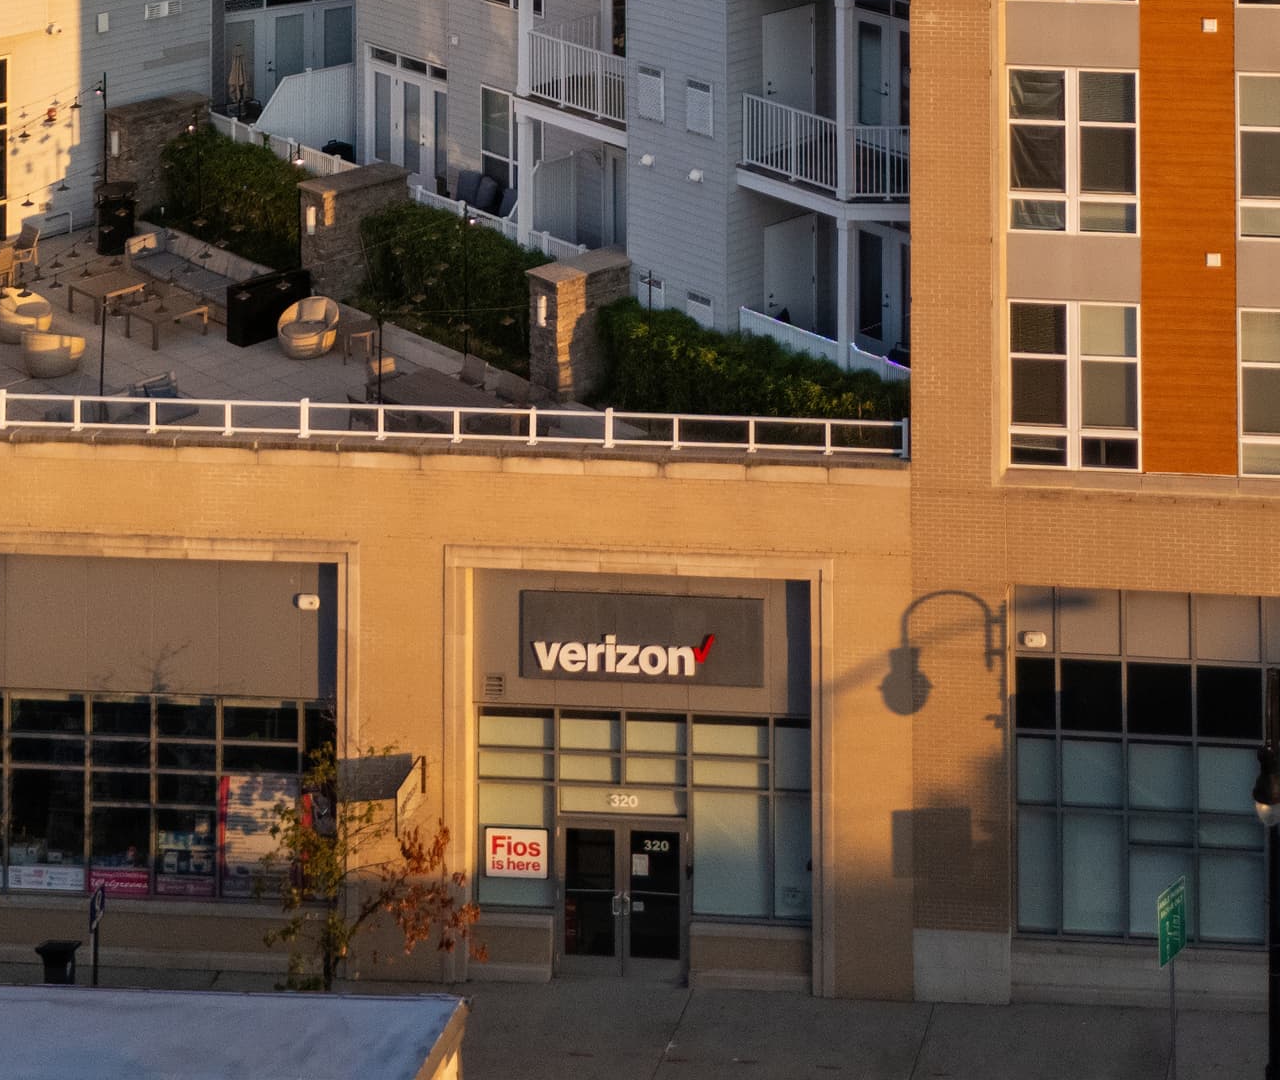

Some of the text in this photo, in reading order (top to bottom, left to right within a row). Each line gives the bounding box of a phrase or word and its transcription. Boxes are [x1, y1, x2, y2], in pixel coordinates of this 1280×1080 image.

[534, 633, 696, 677] verizon
[611, 793, 639, 808] 320
[492, 835, 541, 857] Fios
[643, 839, 670, 851] 320
[492, 857, 541, 871] is here
